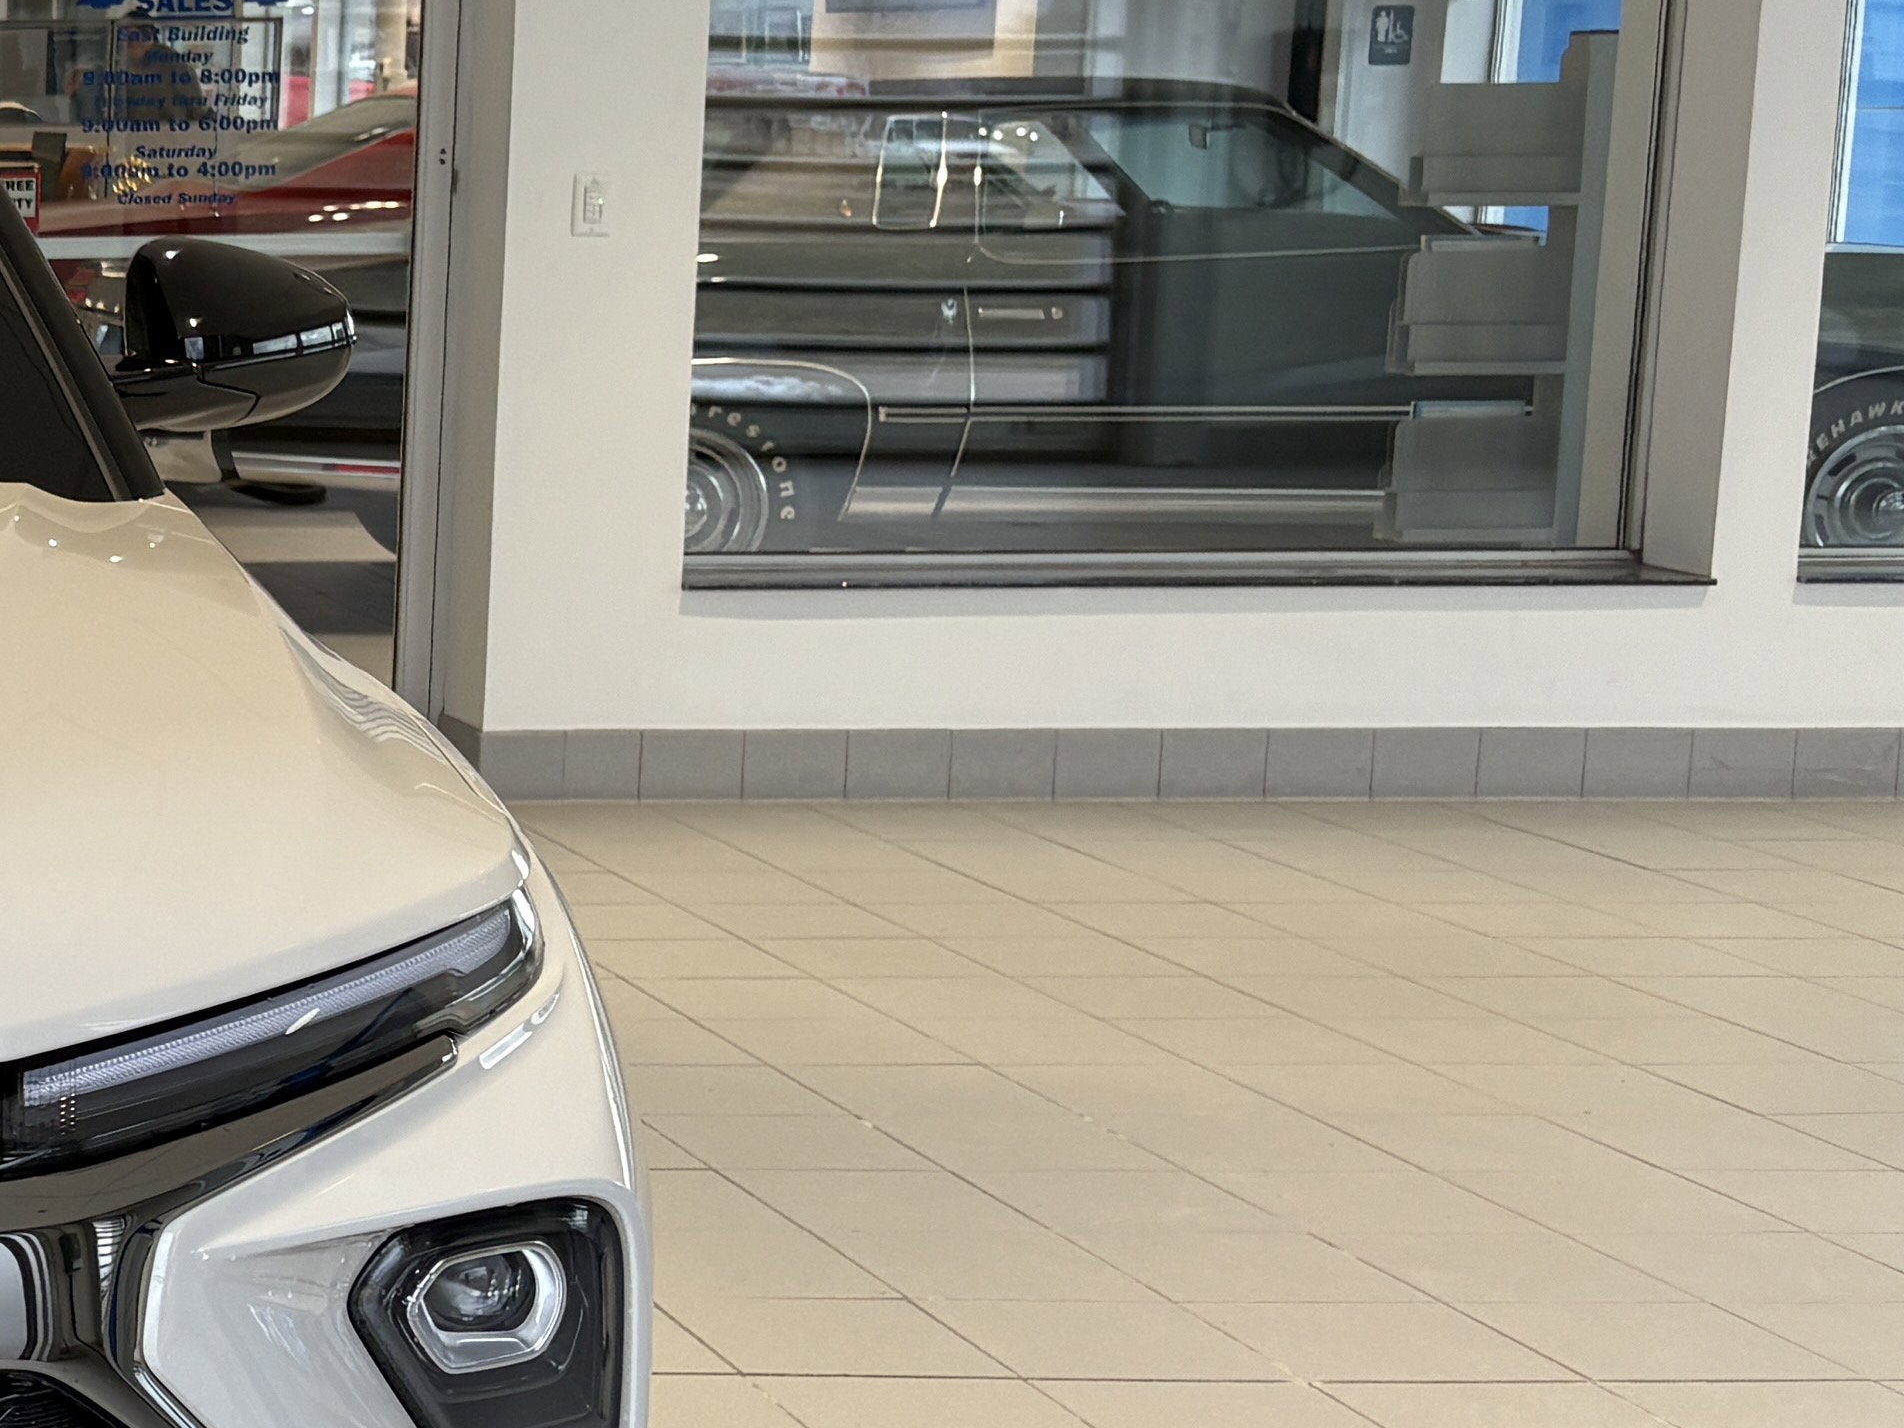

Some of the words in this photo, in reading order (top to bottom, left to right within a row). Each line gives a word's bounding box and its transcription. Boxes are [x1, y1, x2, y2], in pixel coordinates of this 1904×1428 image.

[168, 25, 250, 44] Building
[199, 69, 280, 86] 8:00pm
[169, 116, 191, 132] to
[135, 145, 217, 159] Saturday
[170, 162, 191, 178] to
[196, 161, 276, 178] 4:00pm
